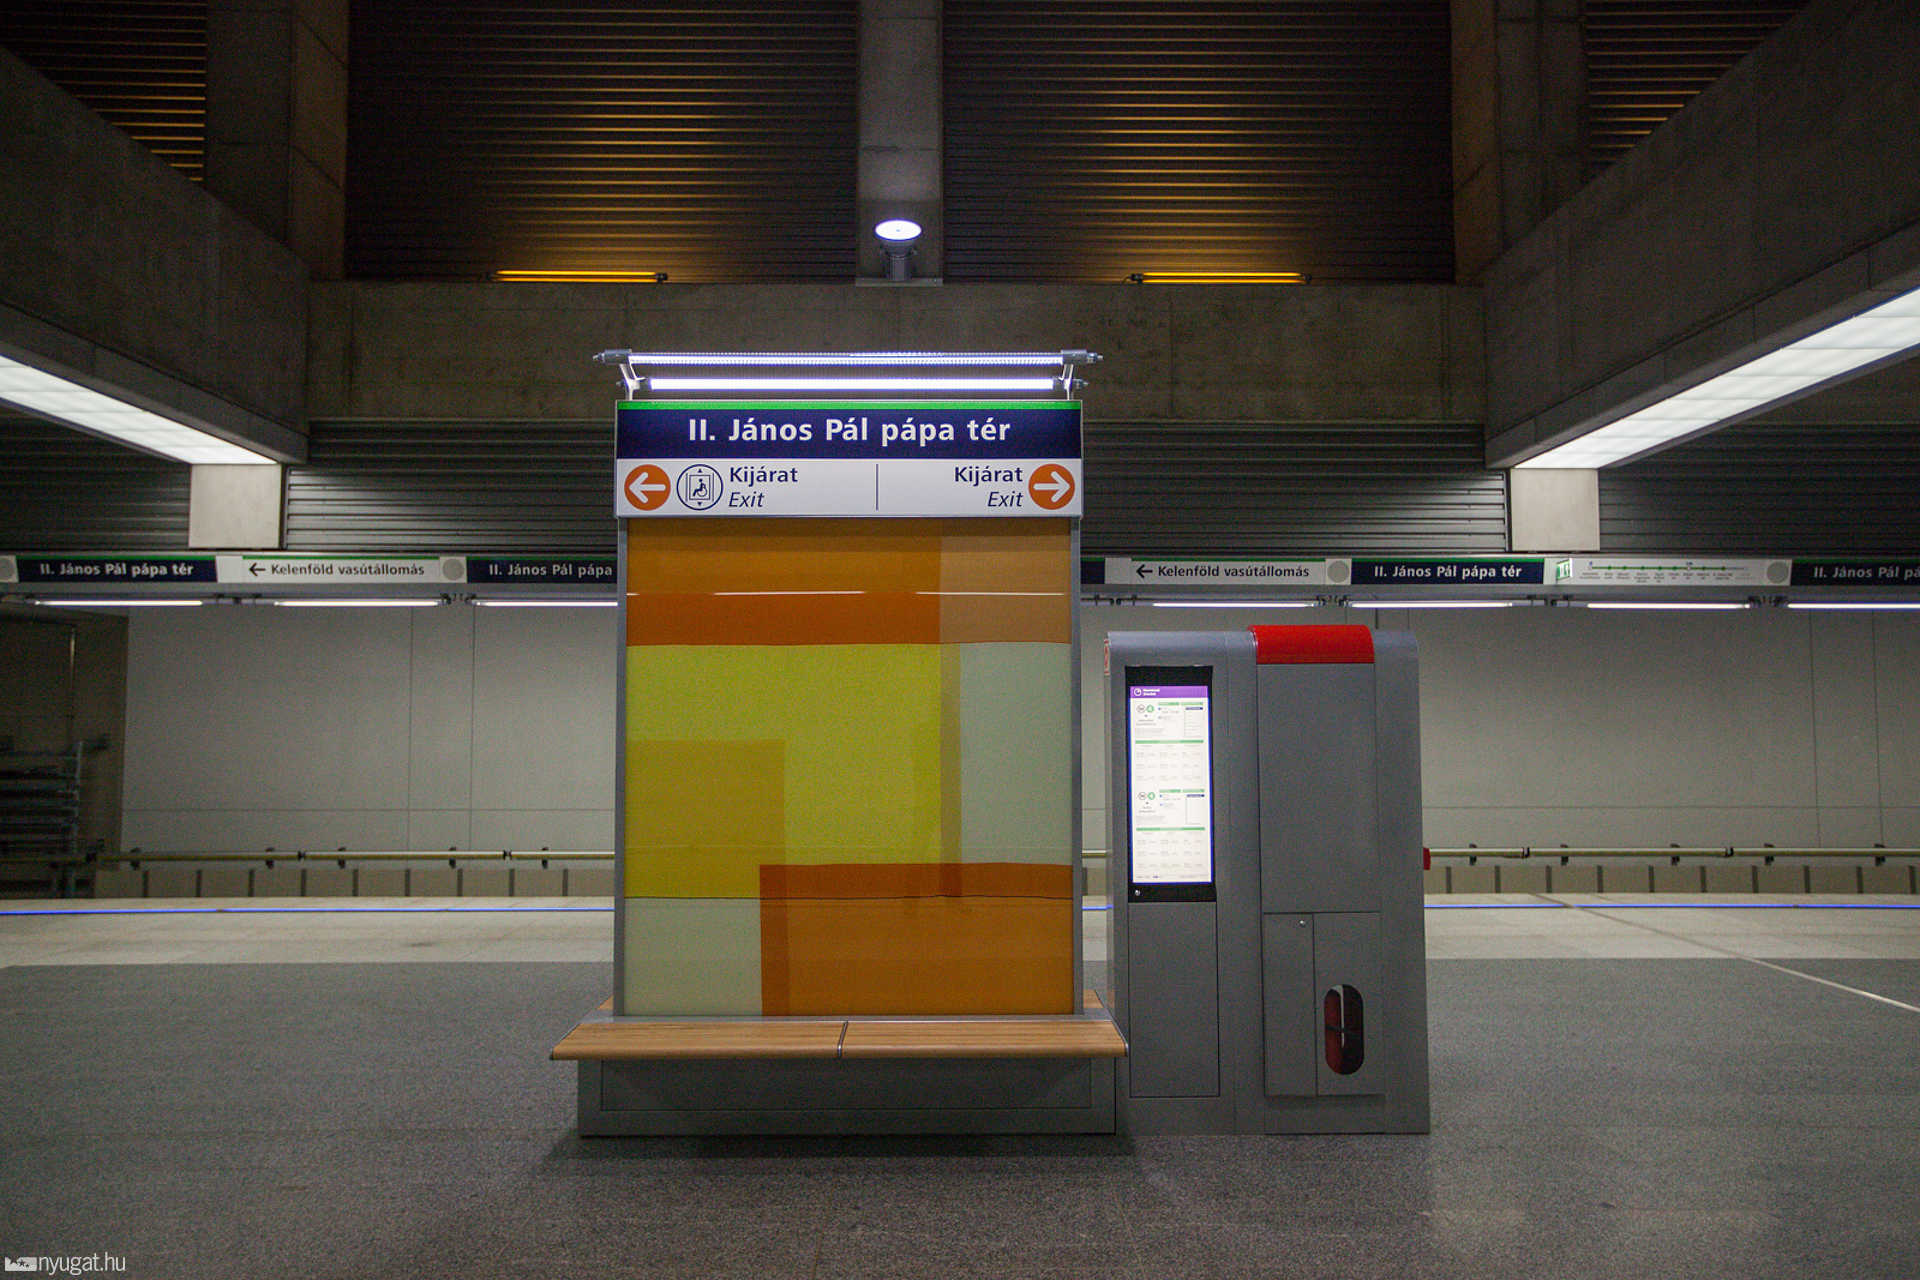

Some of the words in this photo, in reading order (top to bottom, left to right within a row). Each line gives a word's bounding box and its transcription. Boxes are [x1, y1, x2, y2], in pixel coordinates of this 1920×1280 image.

[689, 418, 716, 441] II.
[728, 416, 813, 441] János
[826, 416, 868, 441] Pál
[881, 416, 955, 447] pápa
[966, 416, 1011, 441] tér
[729, 465, 799, 488] Kijárat
[954, 465, 1024, 488] Kijárat
[727, 490, 765, 508] Exit
[986, 490, 1024, 508] Exit
[39, 563, 55, 575] II.
[59, 562, 100, 575] János
[105, 562, 127, 575] Pál
[131, 562, 169, 579] pápa
[172, 563, 194, 576] tér
[271, 562, 334, 575] Kelenföld
[338, 562, 426, 576] vasútállomás
[488, 563, 503, 575] II.
[507, 563, 547, 576] János
[552, 563, 573, 575] Pál
[578, 563, 613, 579] pápa
[1157, 564, 1220, 577] Kelenföld
[1223, 564, 1311, 577] vasútállomás
[1373, 565, 1388, 577] II.
[1391, 564, 1432, 577] János
[1436, 564, 1457, 577] Pál
[1461, 564, 1497, 580] pápa
[1500, 564, 1523, 577] tér
[1832, 565, 1873, 578] János
[1878, 565, 1900, 578] Pál
[1904, 566, 1920, 581] pá
